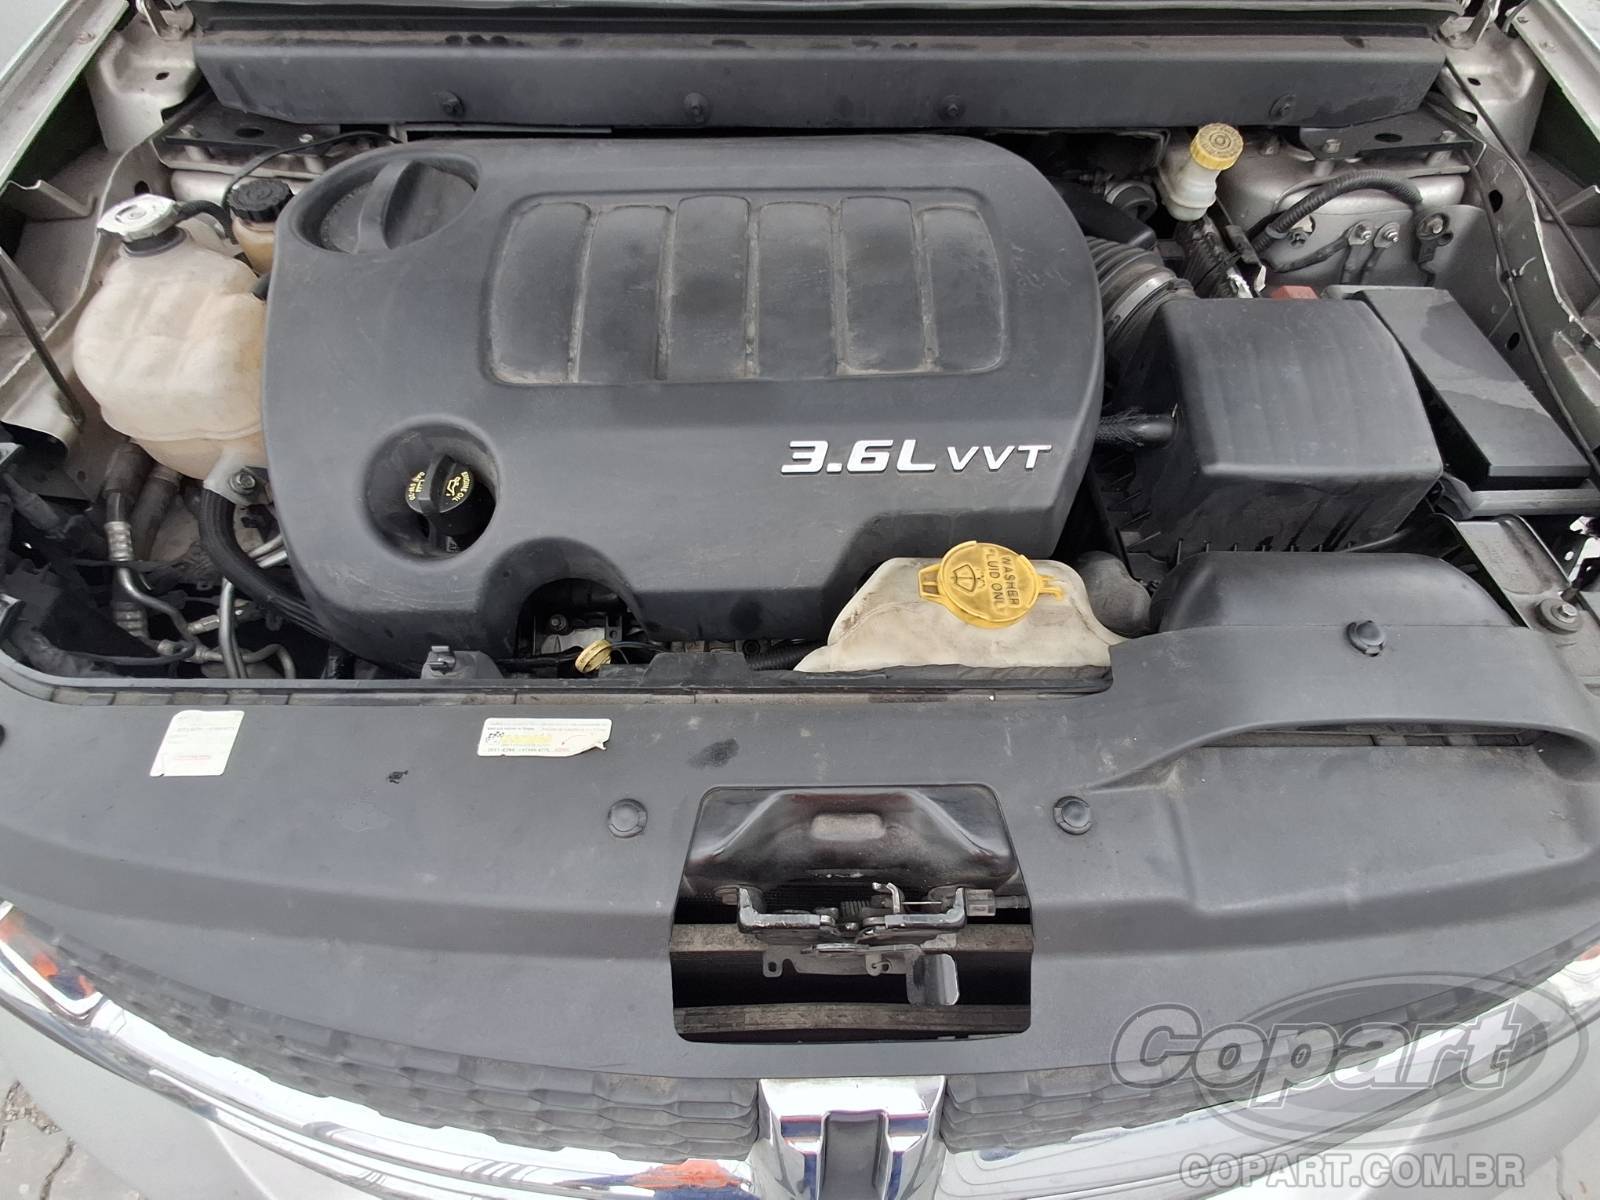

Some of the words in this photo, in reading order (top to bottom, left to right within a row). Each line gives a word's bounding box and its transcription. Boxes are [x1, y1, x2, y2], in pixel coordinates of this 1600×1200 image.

[781, 440, 936, 474] 3.6L
[947, 445, 1052, 472] VVT
[452, 492, 465, 502] OIL
[1001, 557, 1019, 605] WASHER
